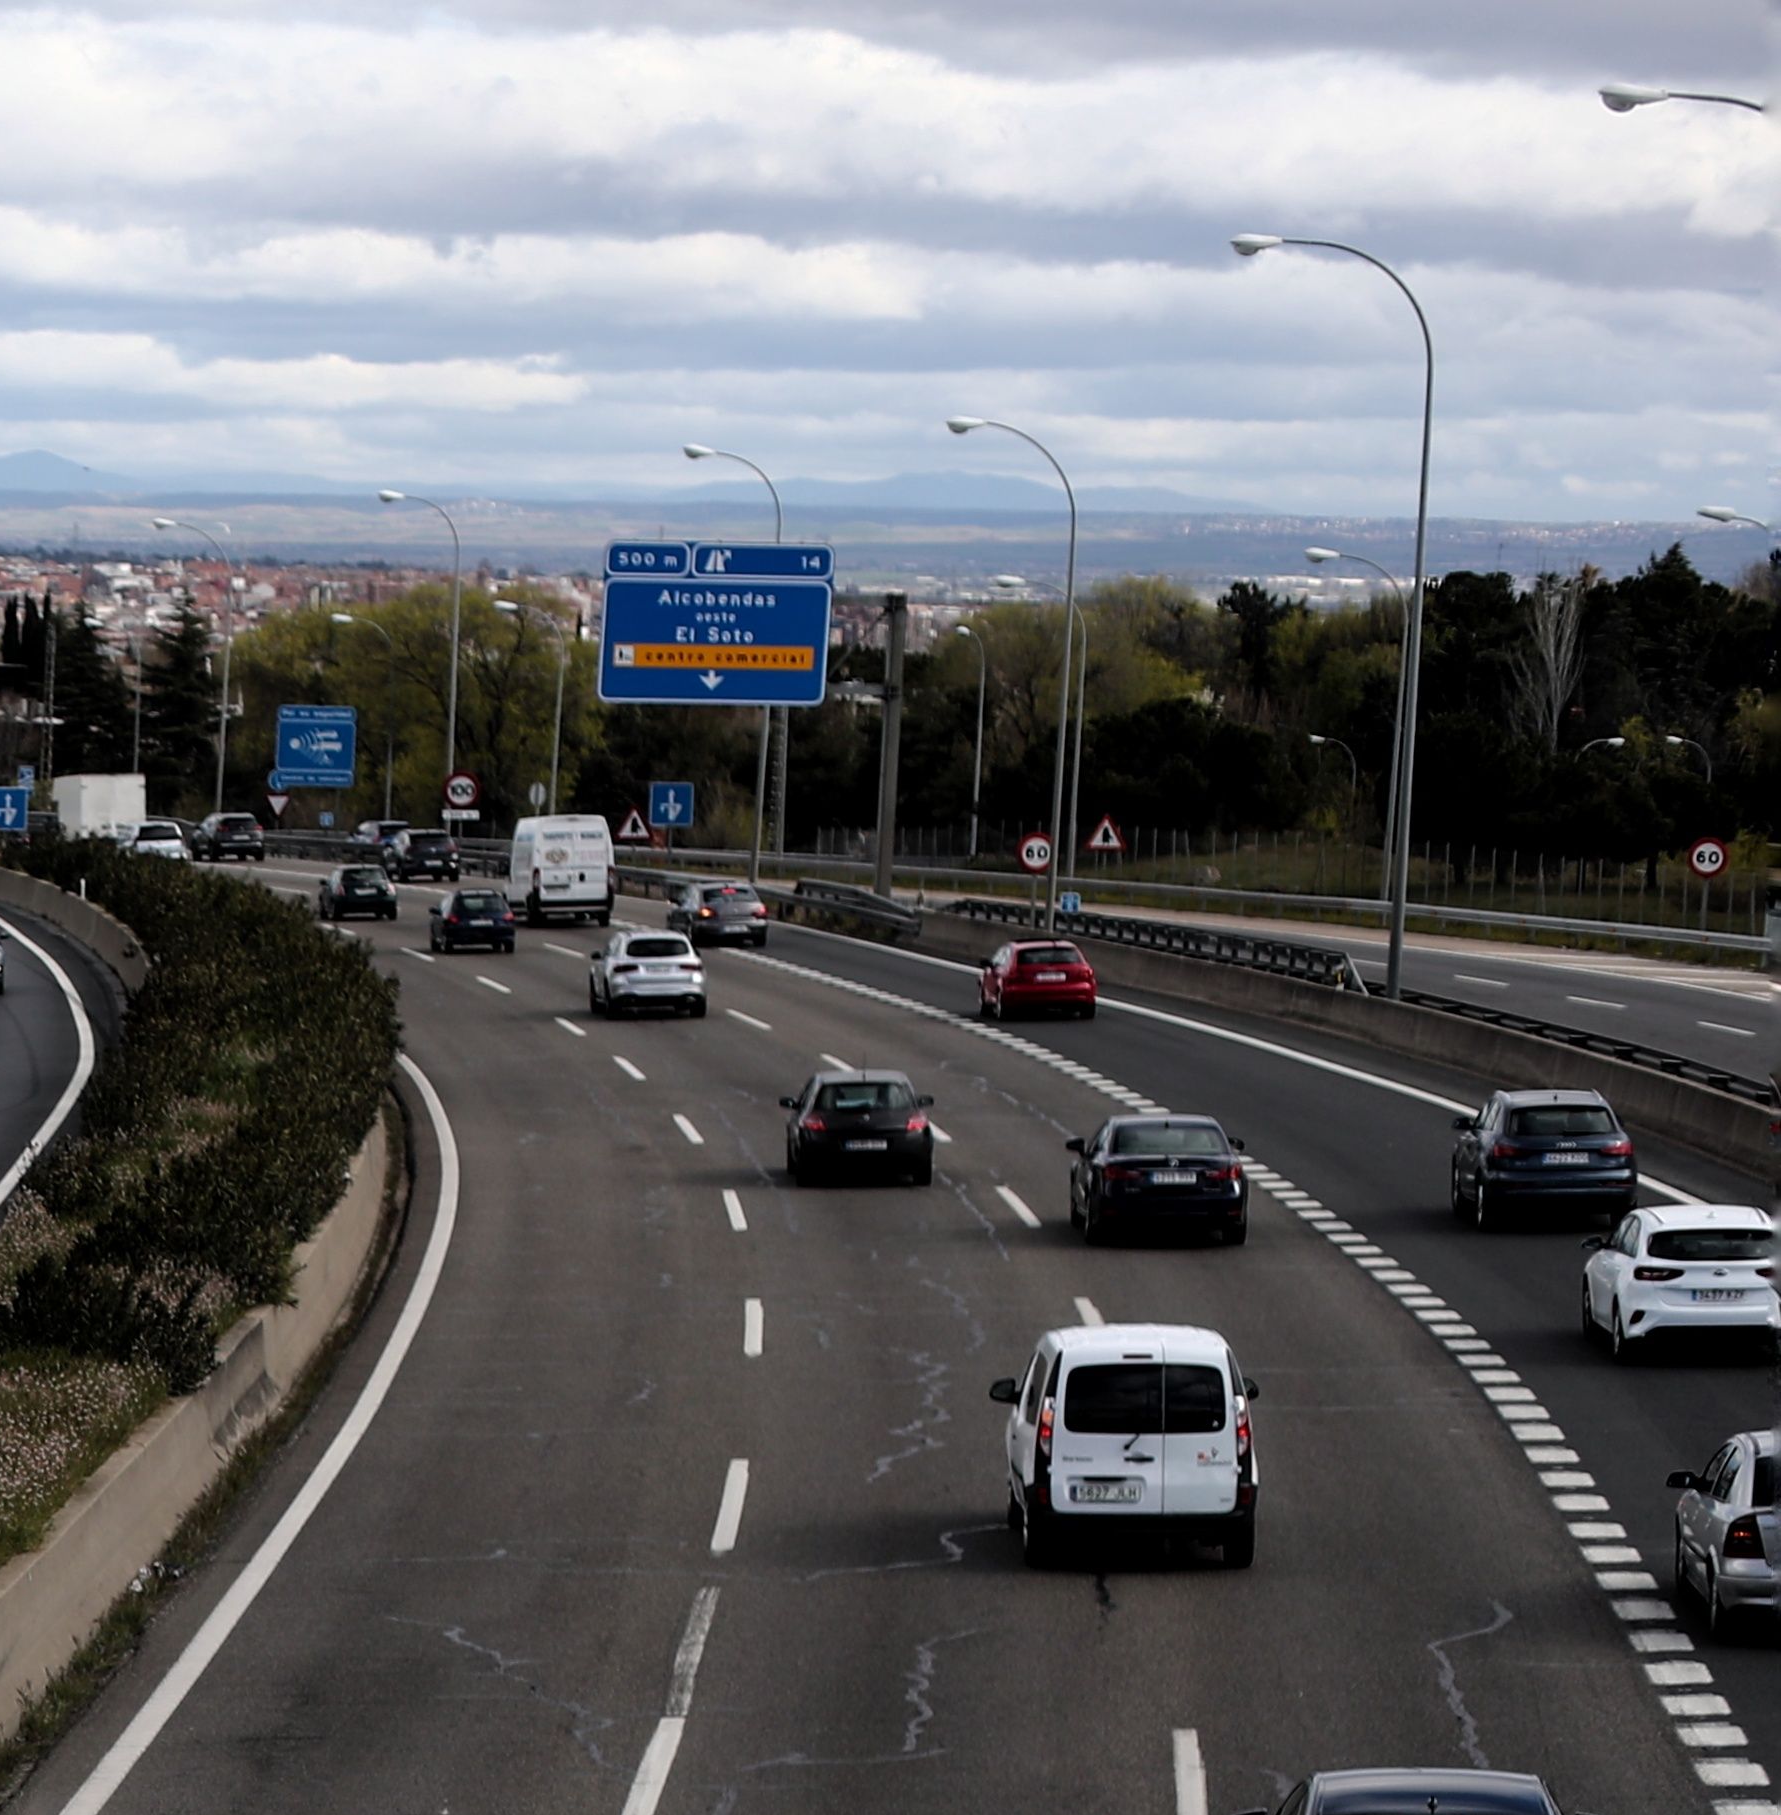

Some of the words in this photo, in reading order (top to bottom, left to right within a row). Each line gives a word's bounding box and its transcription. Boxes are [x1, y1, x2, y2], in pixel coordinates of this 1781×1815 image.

[618, 552, 655, 566] 500
[663, 554, 678, 566] m
[800, 556, 821, 569] 14
[658, 589, 776, 608] Alcobendas
[695, 612, 736, 623] oeste
[675, 626, 695, 642] El
[707, 627, 754, 643] Soto
[645, 649, 706, 662] centro
[714, 650, 805, 665] comercial
[450, 784, 475, 797] 100
[1026, 845, 1048, 858] 60
[1696, 850, 1720, 864] 60
